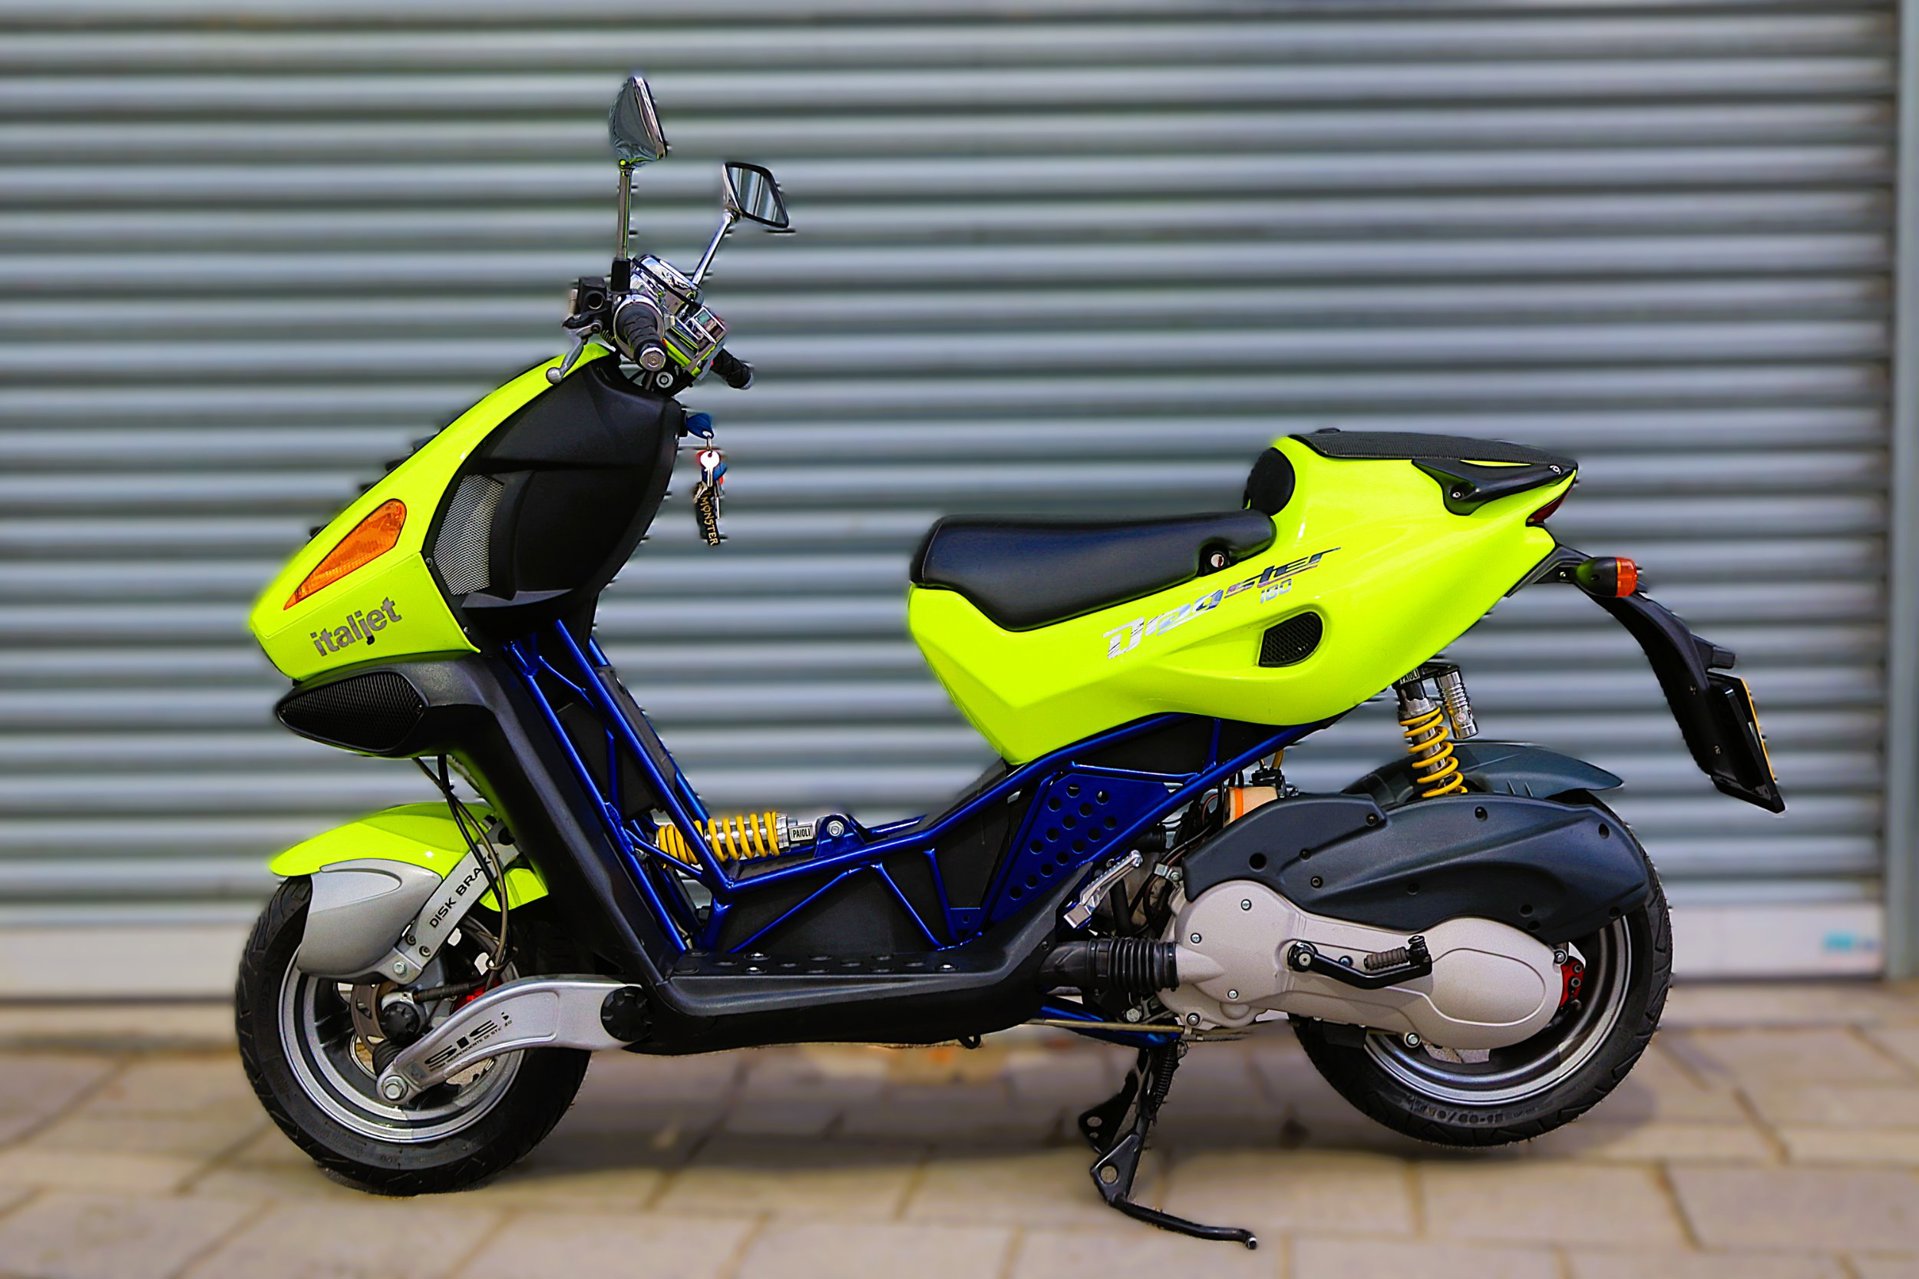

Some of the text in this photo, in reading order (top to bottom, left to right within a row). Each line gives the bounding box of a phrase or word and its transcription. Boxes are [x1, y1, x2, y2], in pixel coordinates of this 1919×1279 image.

[700, 496, 719, 546] MONSTER
[310, 596, 402, 657] italjet
[792, 827, 811, 839] PAIOLI
[429, 897, 457, 928] DISK
